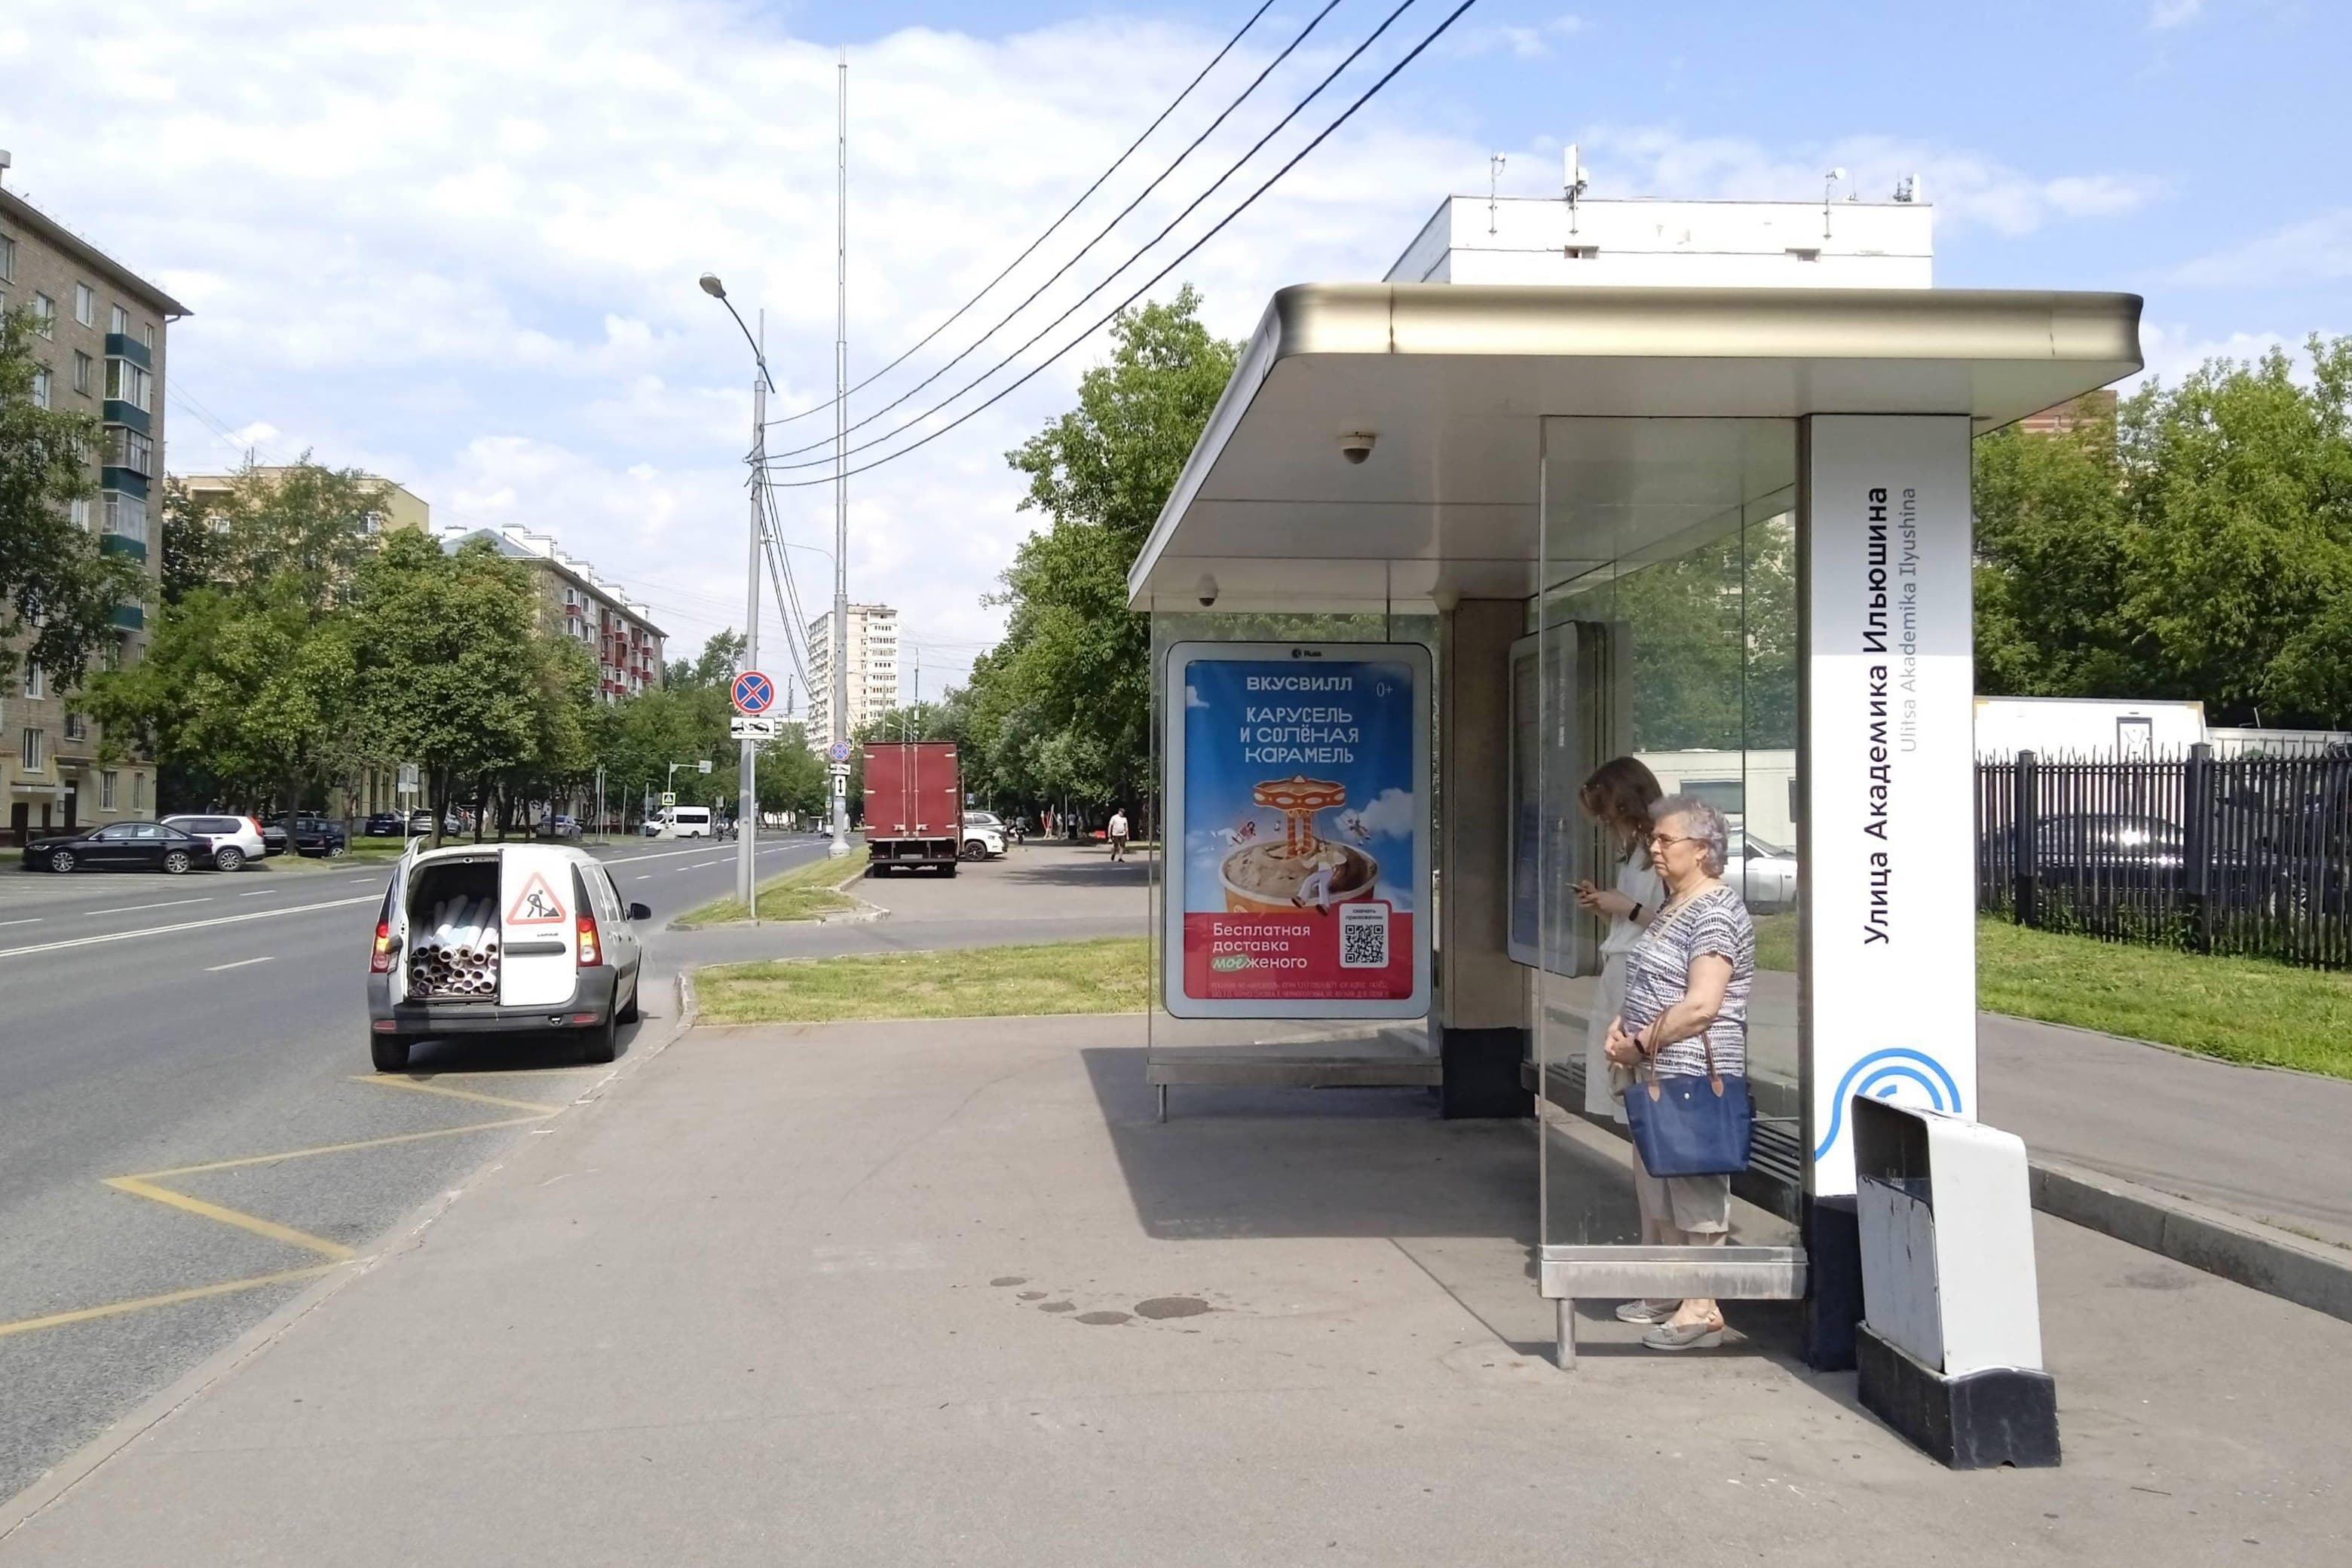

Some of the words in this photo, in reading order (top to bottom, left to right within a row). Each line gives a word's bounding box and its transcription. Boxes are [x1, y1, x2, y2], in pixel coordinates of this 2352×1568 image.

[1898, 488, 1920, 576] Ilyushina
[1863, 488, 1887, 652] Ильюшина
[1898, 583, 1916, 692] Akademika
[1246, 677, 1352, 691] ВКУСВИЛЛ
[1377, 682, 1394, 697] 0+
[1246, 706, 1353, 723] КАРУСЕЛЬ
[1899, 700, 1916, 752] Ulitsa
[1240, 727, 1251, 743] И
[1245, 747, 1355, 764] КАРАМЕЛЬ
[1864, 666, 1891, 841] Академика
[1864, 853, 1891, 944] Улица
[1213, 922, 1311, 936] Бесплатная
[1212, 941, 1289, 953] доставка
